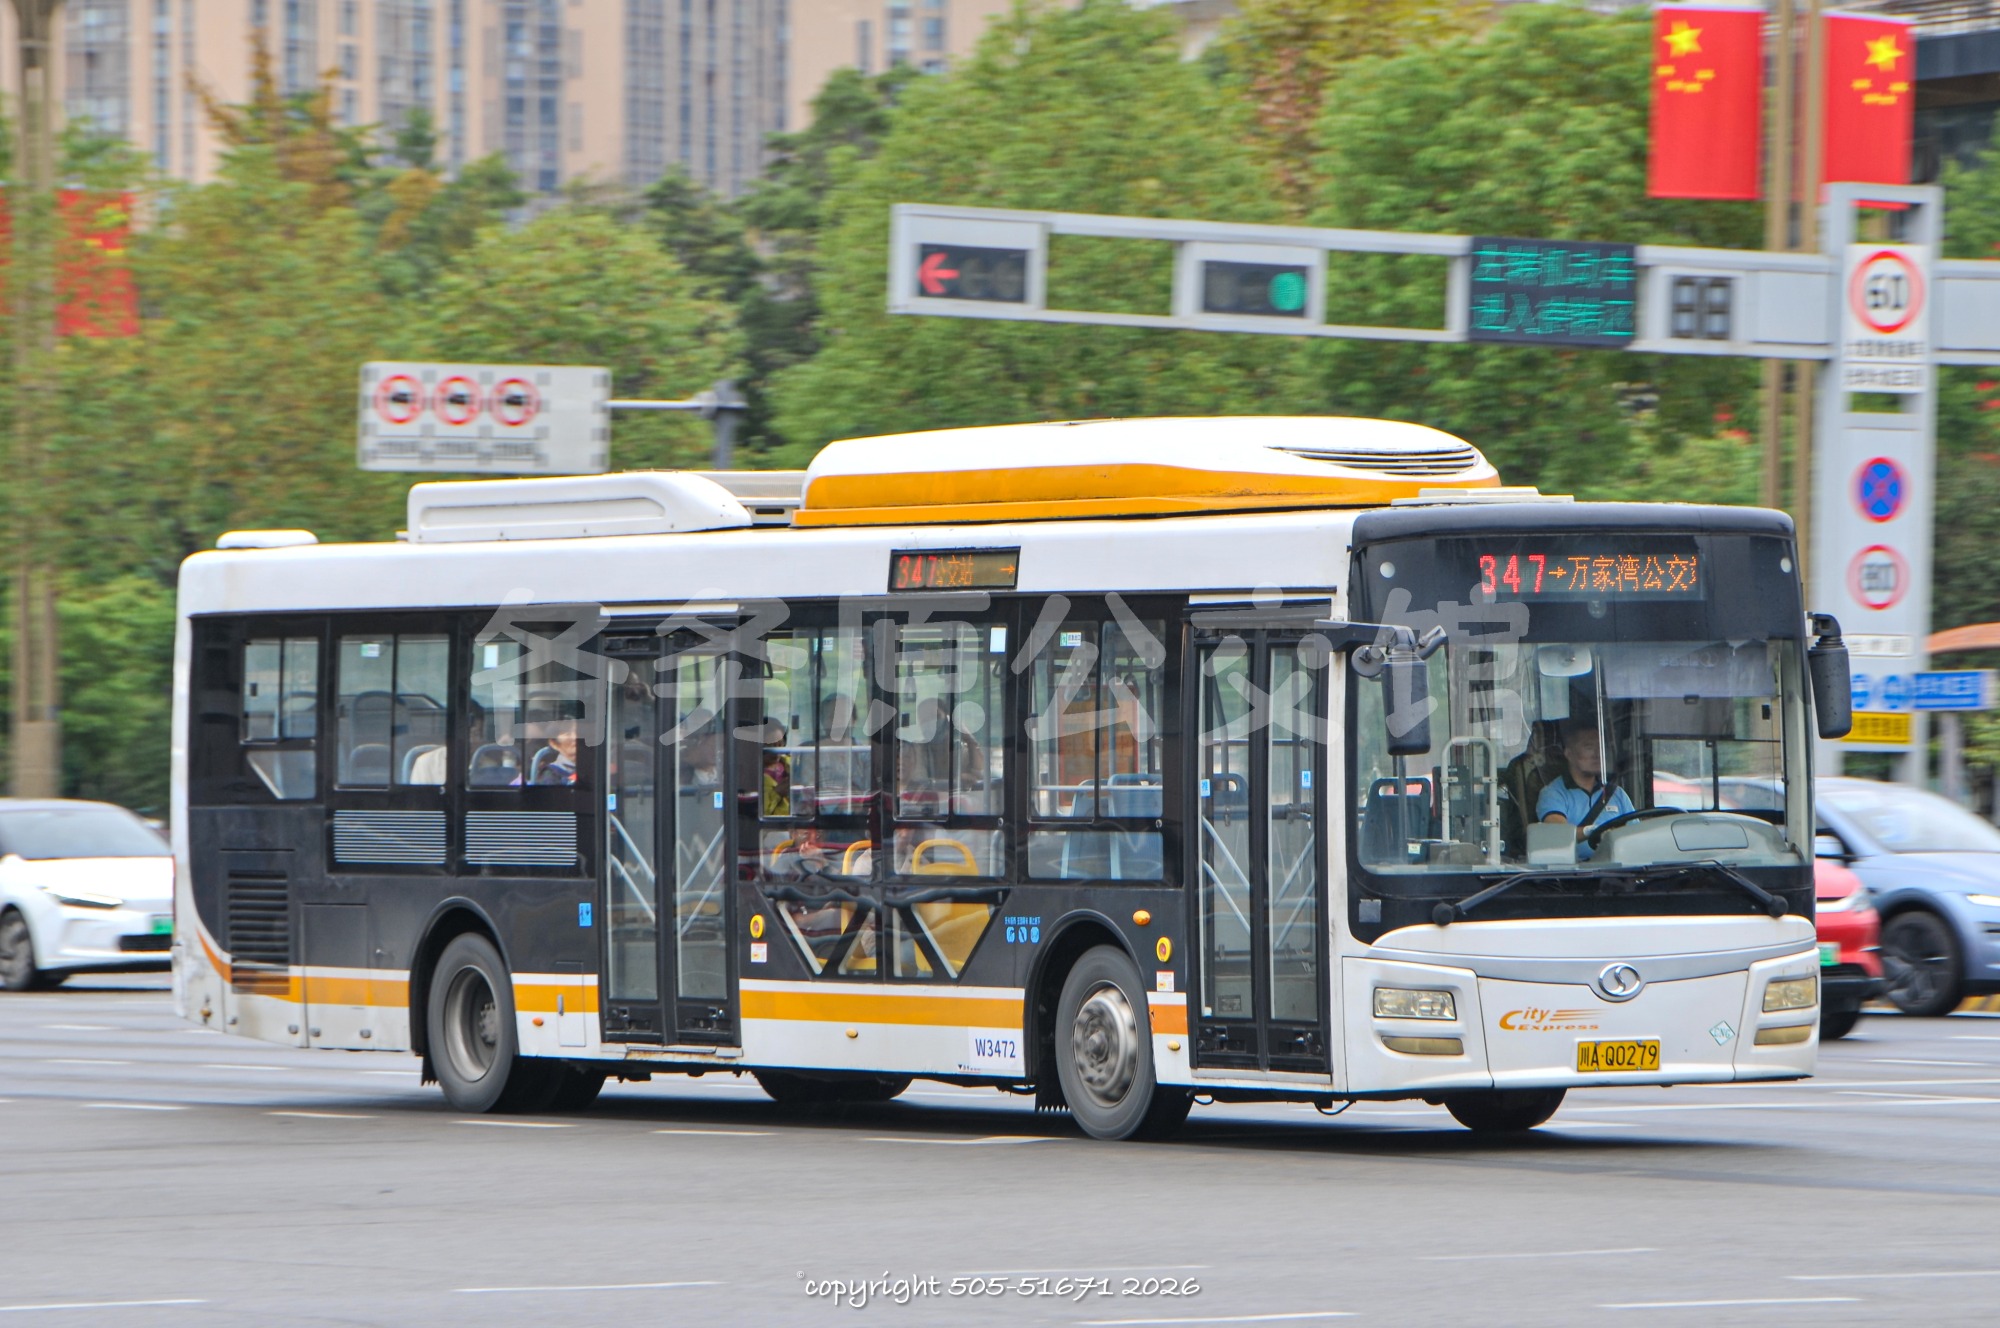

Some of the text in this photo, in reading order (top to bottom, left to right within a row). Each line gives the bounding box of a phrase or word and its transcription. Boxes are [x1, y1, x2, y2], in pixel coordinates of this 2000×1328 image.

[896, 555, 937, 588] 347
[1480, 554, 1697, 593] 347 万家湾公交
[1499, 1007, 1550, 1031] City
[1517, 1023, 1599, 1032] Express
[975, 1038, 1016, 1059] W3472
